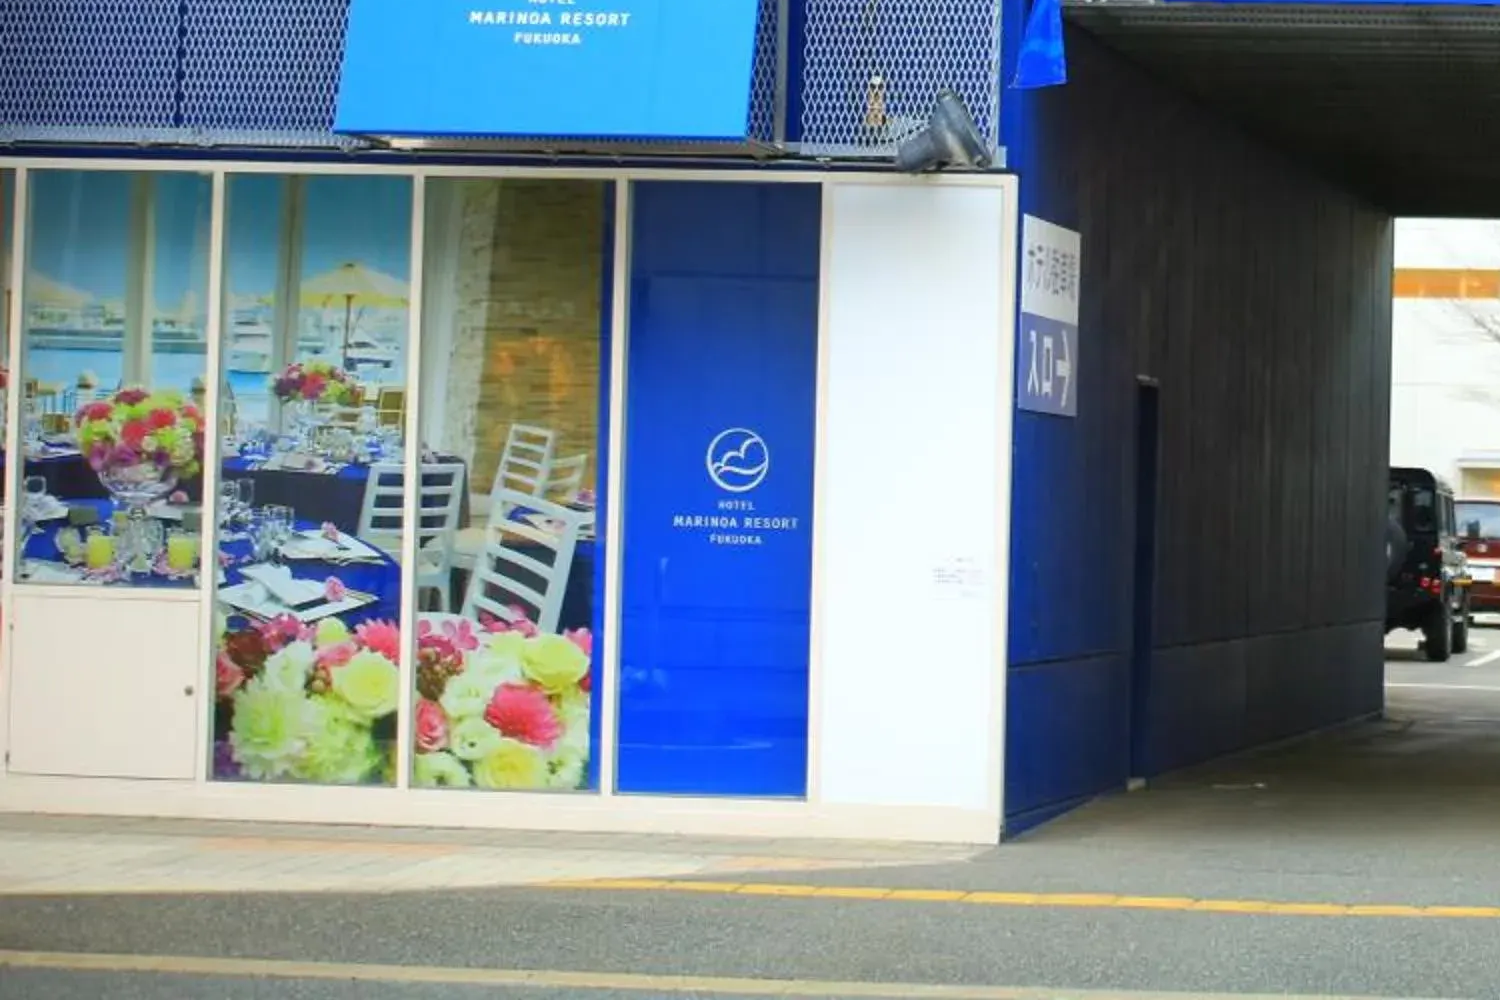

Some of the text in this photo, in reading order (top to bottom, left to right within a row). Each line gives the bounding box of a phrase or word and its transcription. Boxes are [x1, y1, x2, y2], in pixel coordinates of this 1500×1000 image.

[469, 10, 631, 27] MARINOA RESORT
[514, 31, 581, 45] FUKUOKA
[1026, 329, 1054, 397] 入口
[717, 500, 756, 511] HOTEL
[673, 515, 799, 530] MARINOA RESORT
[709, 534, 762, 545] FUKUOKA
